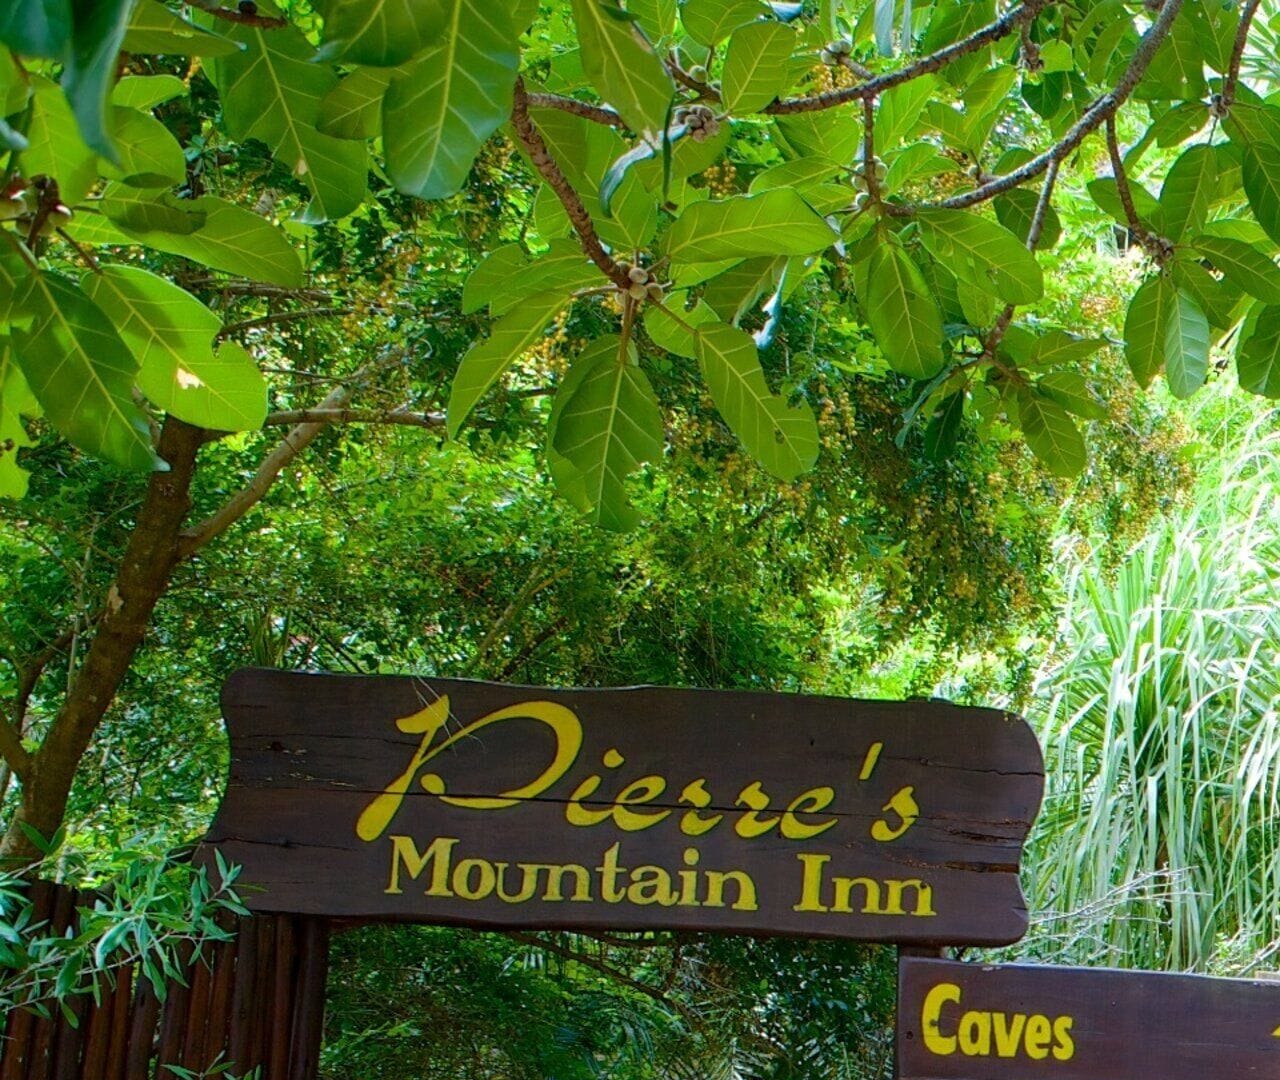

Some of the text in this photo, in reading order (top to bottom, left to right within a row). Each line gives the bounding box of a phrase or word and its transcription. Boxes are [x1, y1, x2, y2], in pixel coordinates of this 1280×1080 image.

[355, 693, 921, 842] Pierre's
[385, 835, 937, 917] Mountain Inn
[921, 983, 1075, 1061] Caves
